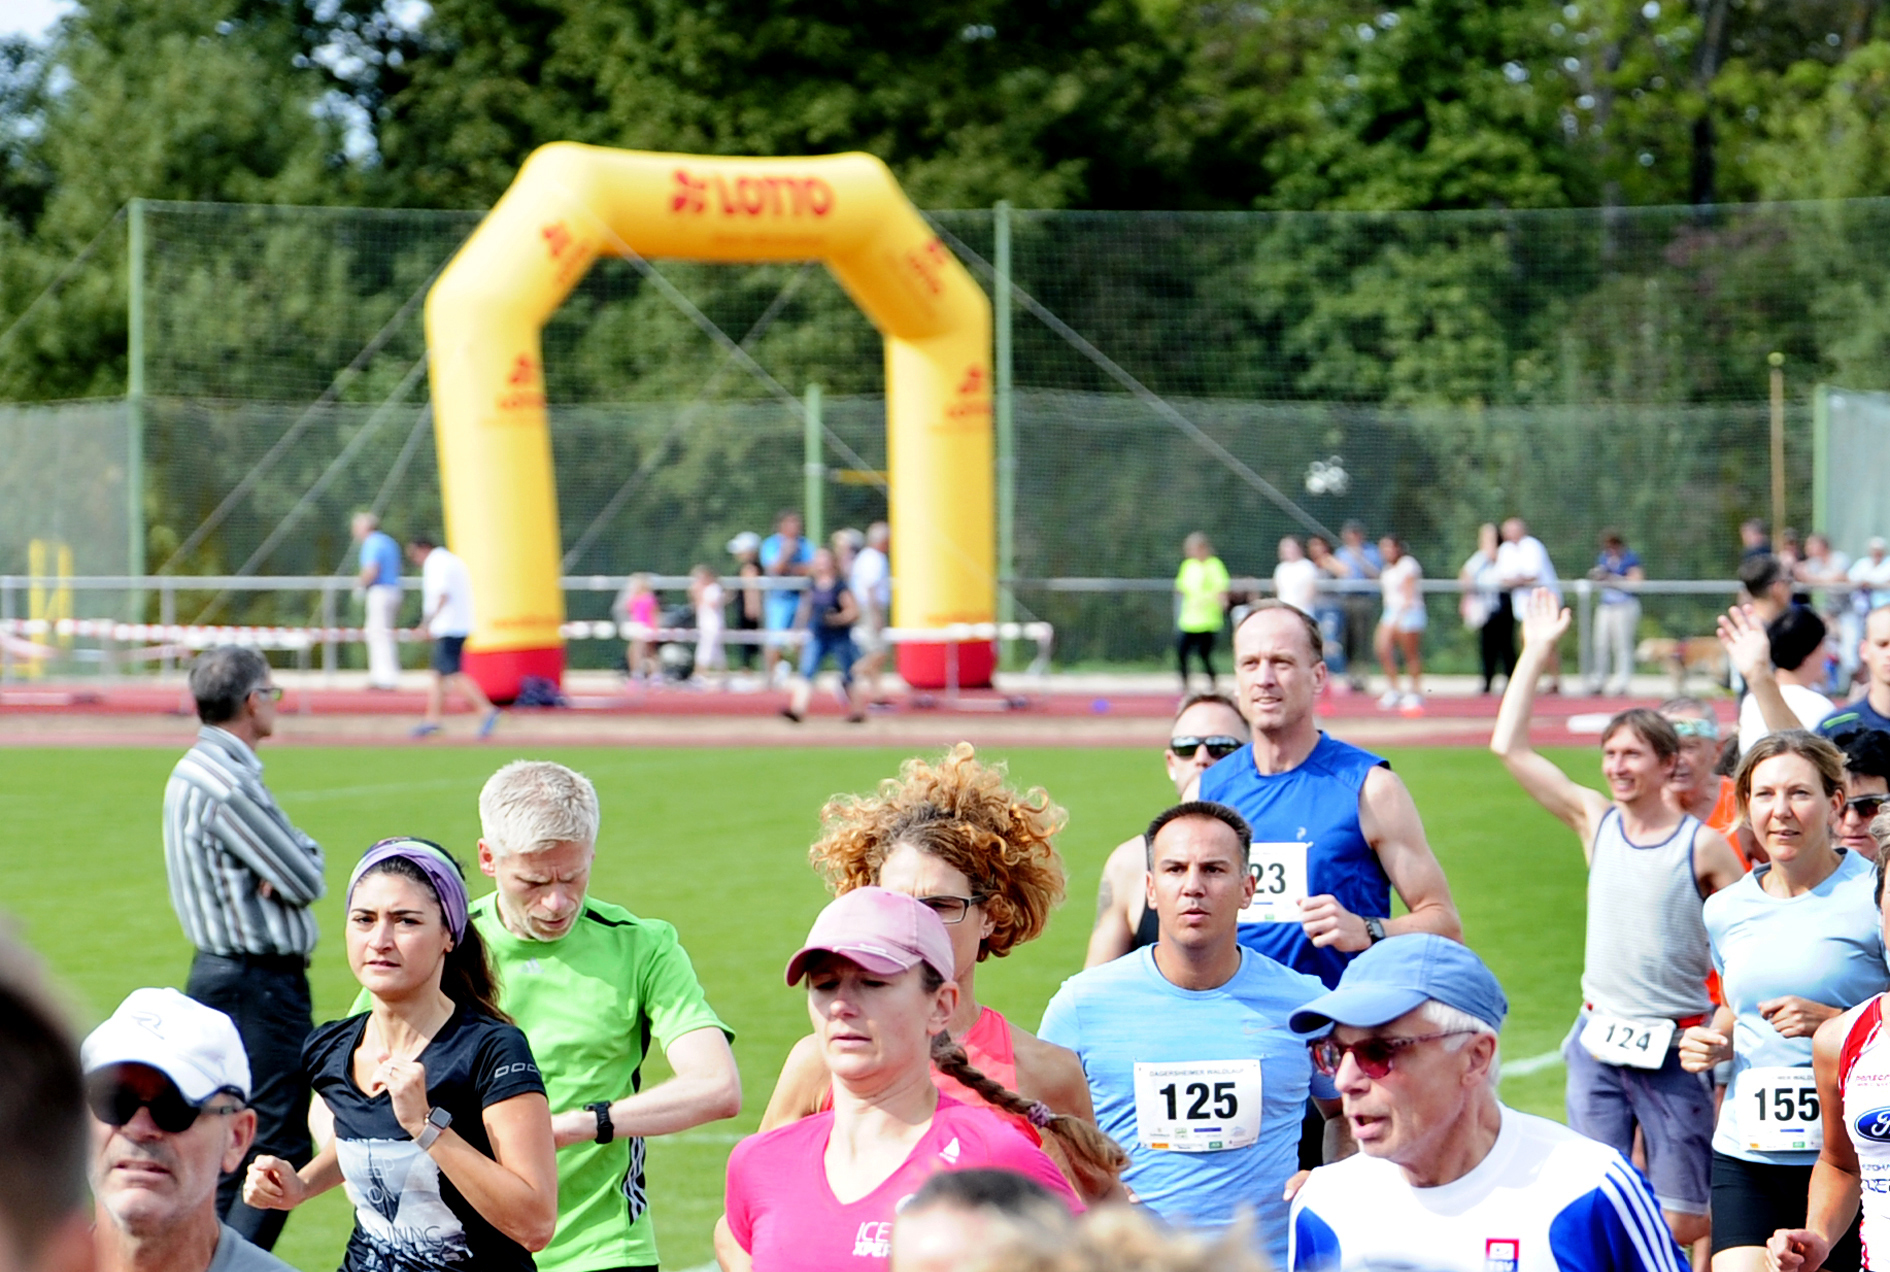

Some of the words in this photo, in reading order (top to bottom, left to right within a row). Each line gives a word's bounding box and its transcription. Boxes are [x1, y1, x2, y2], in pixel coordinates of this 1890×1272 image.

[716, 176, 836, 217] LOTTO
[1606, 1023, 1651, 1051] 124
[1159, 1082, 1239, 1120] 125
[1754, 1087, 1820, 1122] 155
[855, 1221, 893, 1242] ICE
